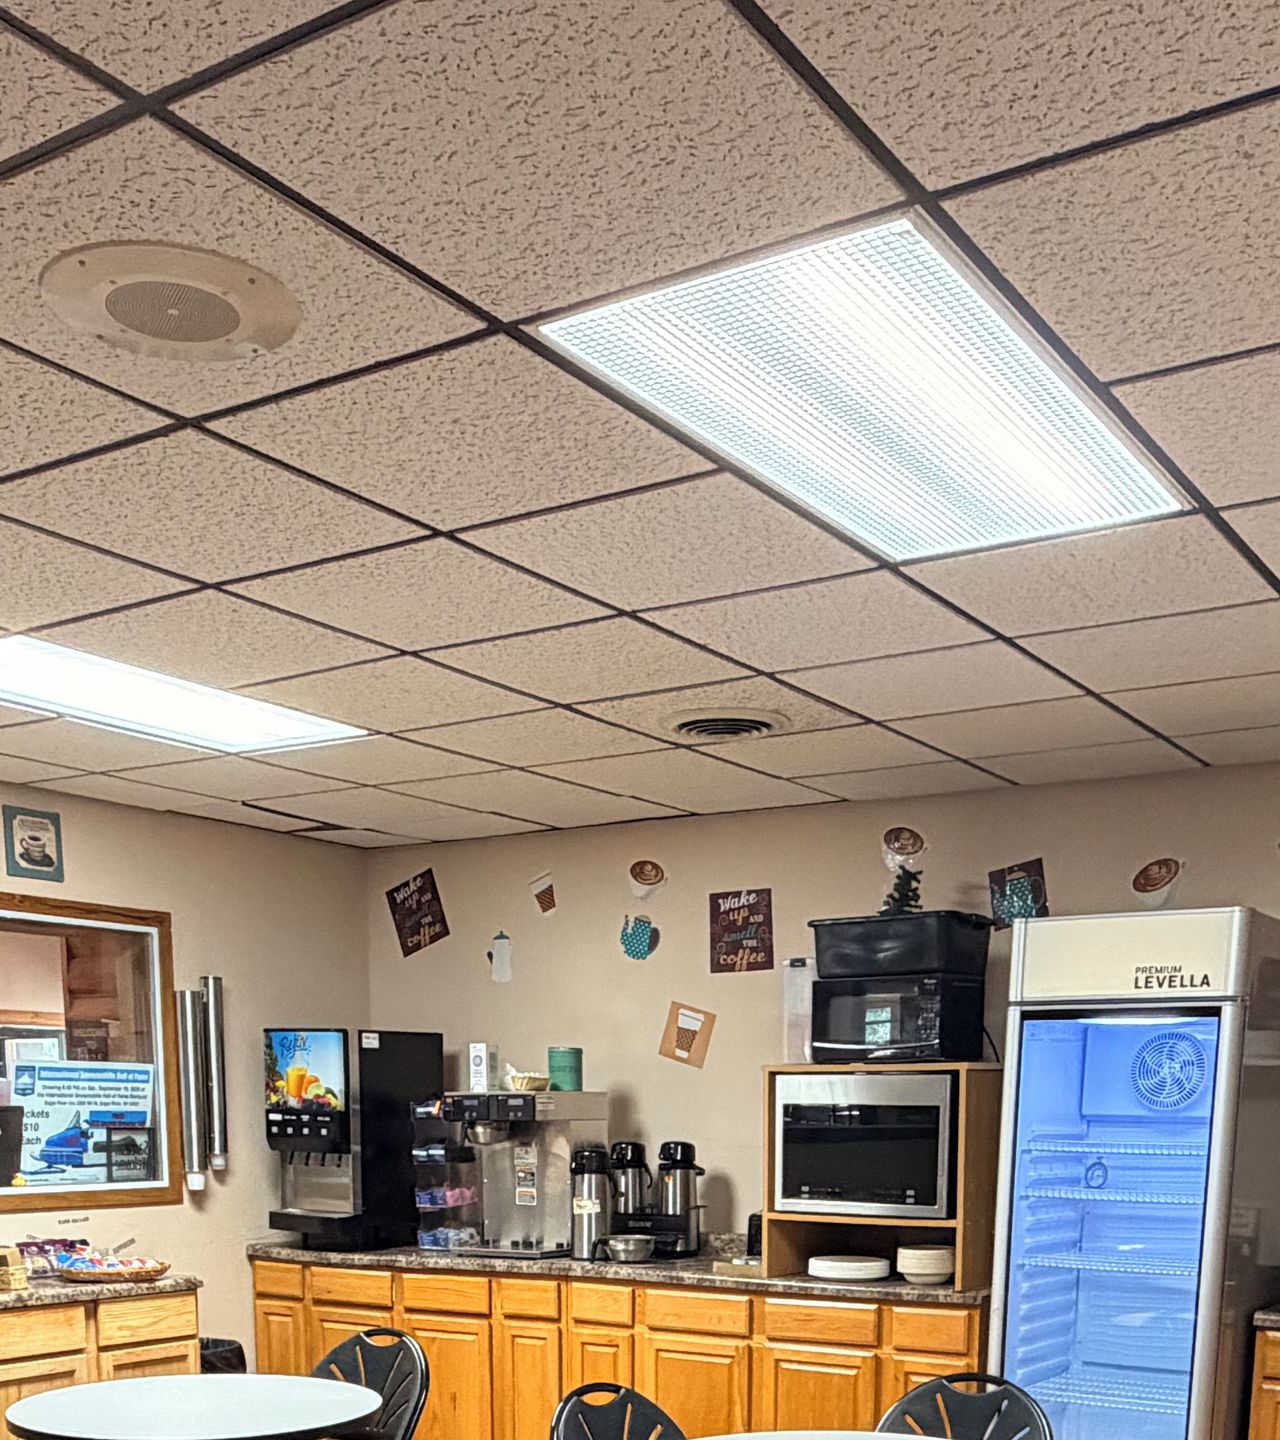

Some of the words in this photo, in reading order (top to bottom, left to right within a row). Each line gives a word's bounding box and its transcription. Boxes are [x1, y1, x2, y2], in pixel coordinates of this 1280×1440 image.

[393, 876, 424, 904] Wake
[718, 890, 758, 912] Wake
[729, 907, 750, 926] up
[407, 922, 443, 947] coffee
[720, 948, 766, 971] coffee
[1135, 965, 1182, 975] PREMIUM
[1134, 973, 1211, 989] LEVELLA
[23, 1108, 50, 1119] ckets
